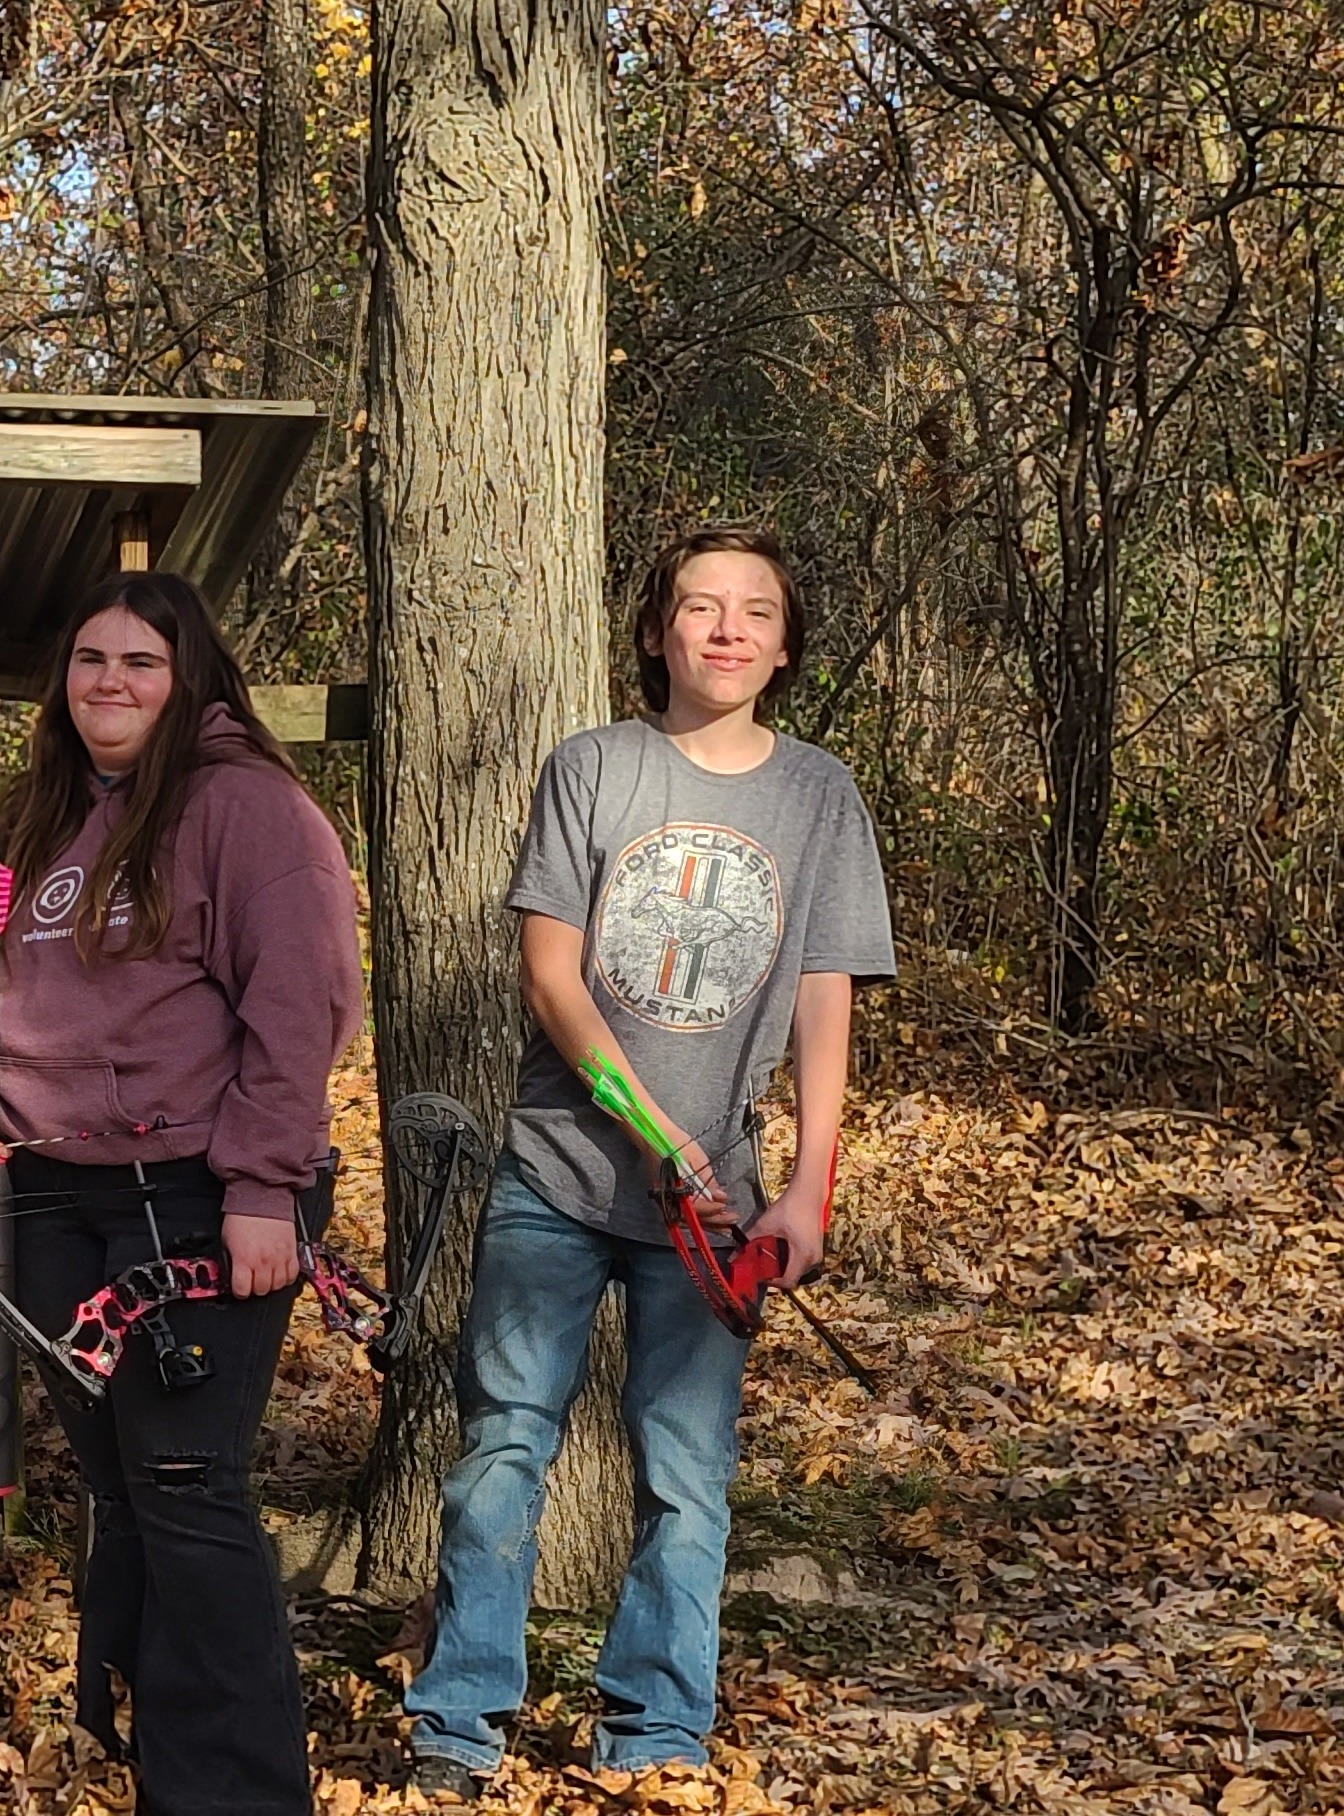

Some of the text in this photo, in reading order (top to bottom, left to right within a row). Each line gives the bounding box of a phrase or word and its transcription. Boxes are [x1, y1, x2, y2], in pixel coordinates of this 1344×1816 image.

[616, 834, 678, 887] FORD
[692, 833, 774, 915] CLASSIC
[21, 927, 74, 943] volunteer
